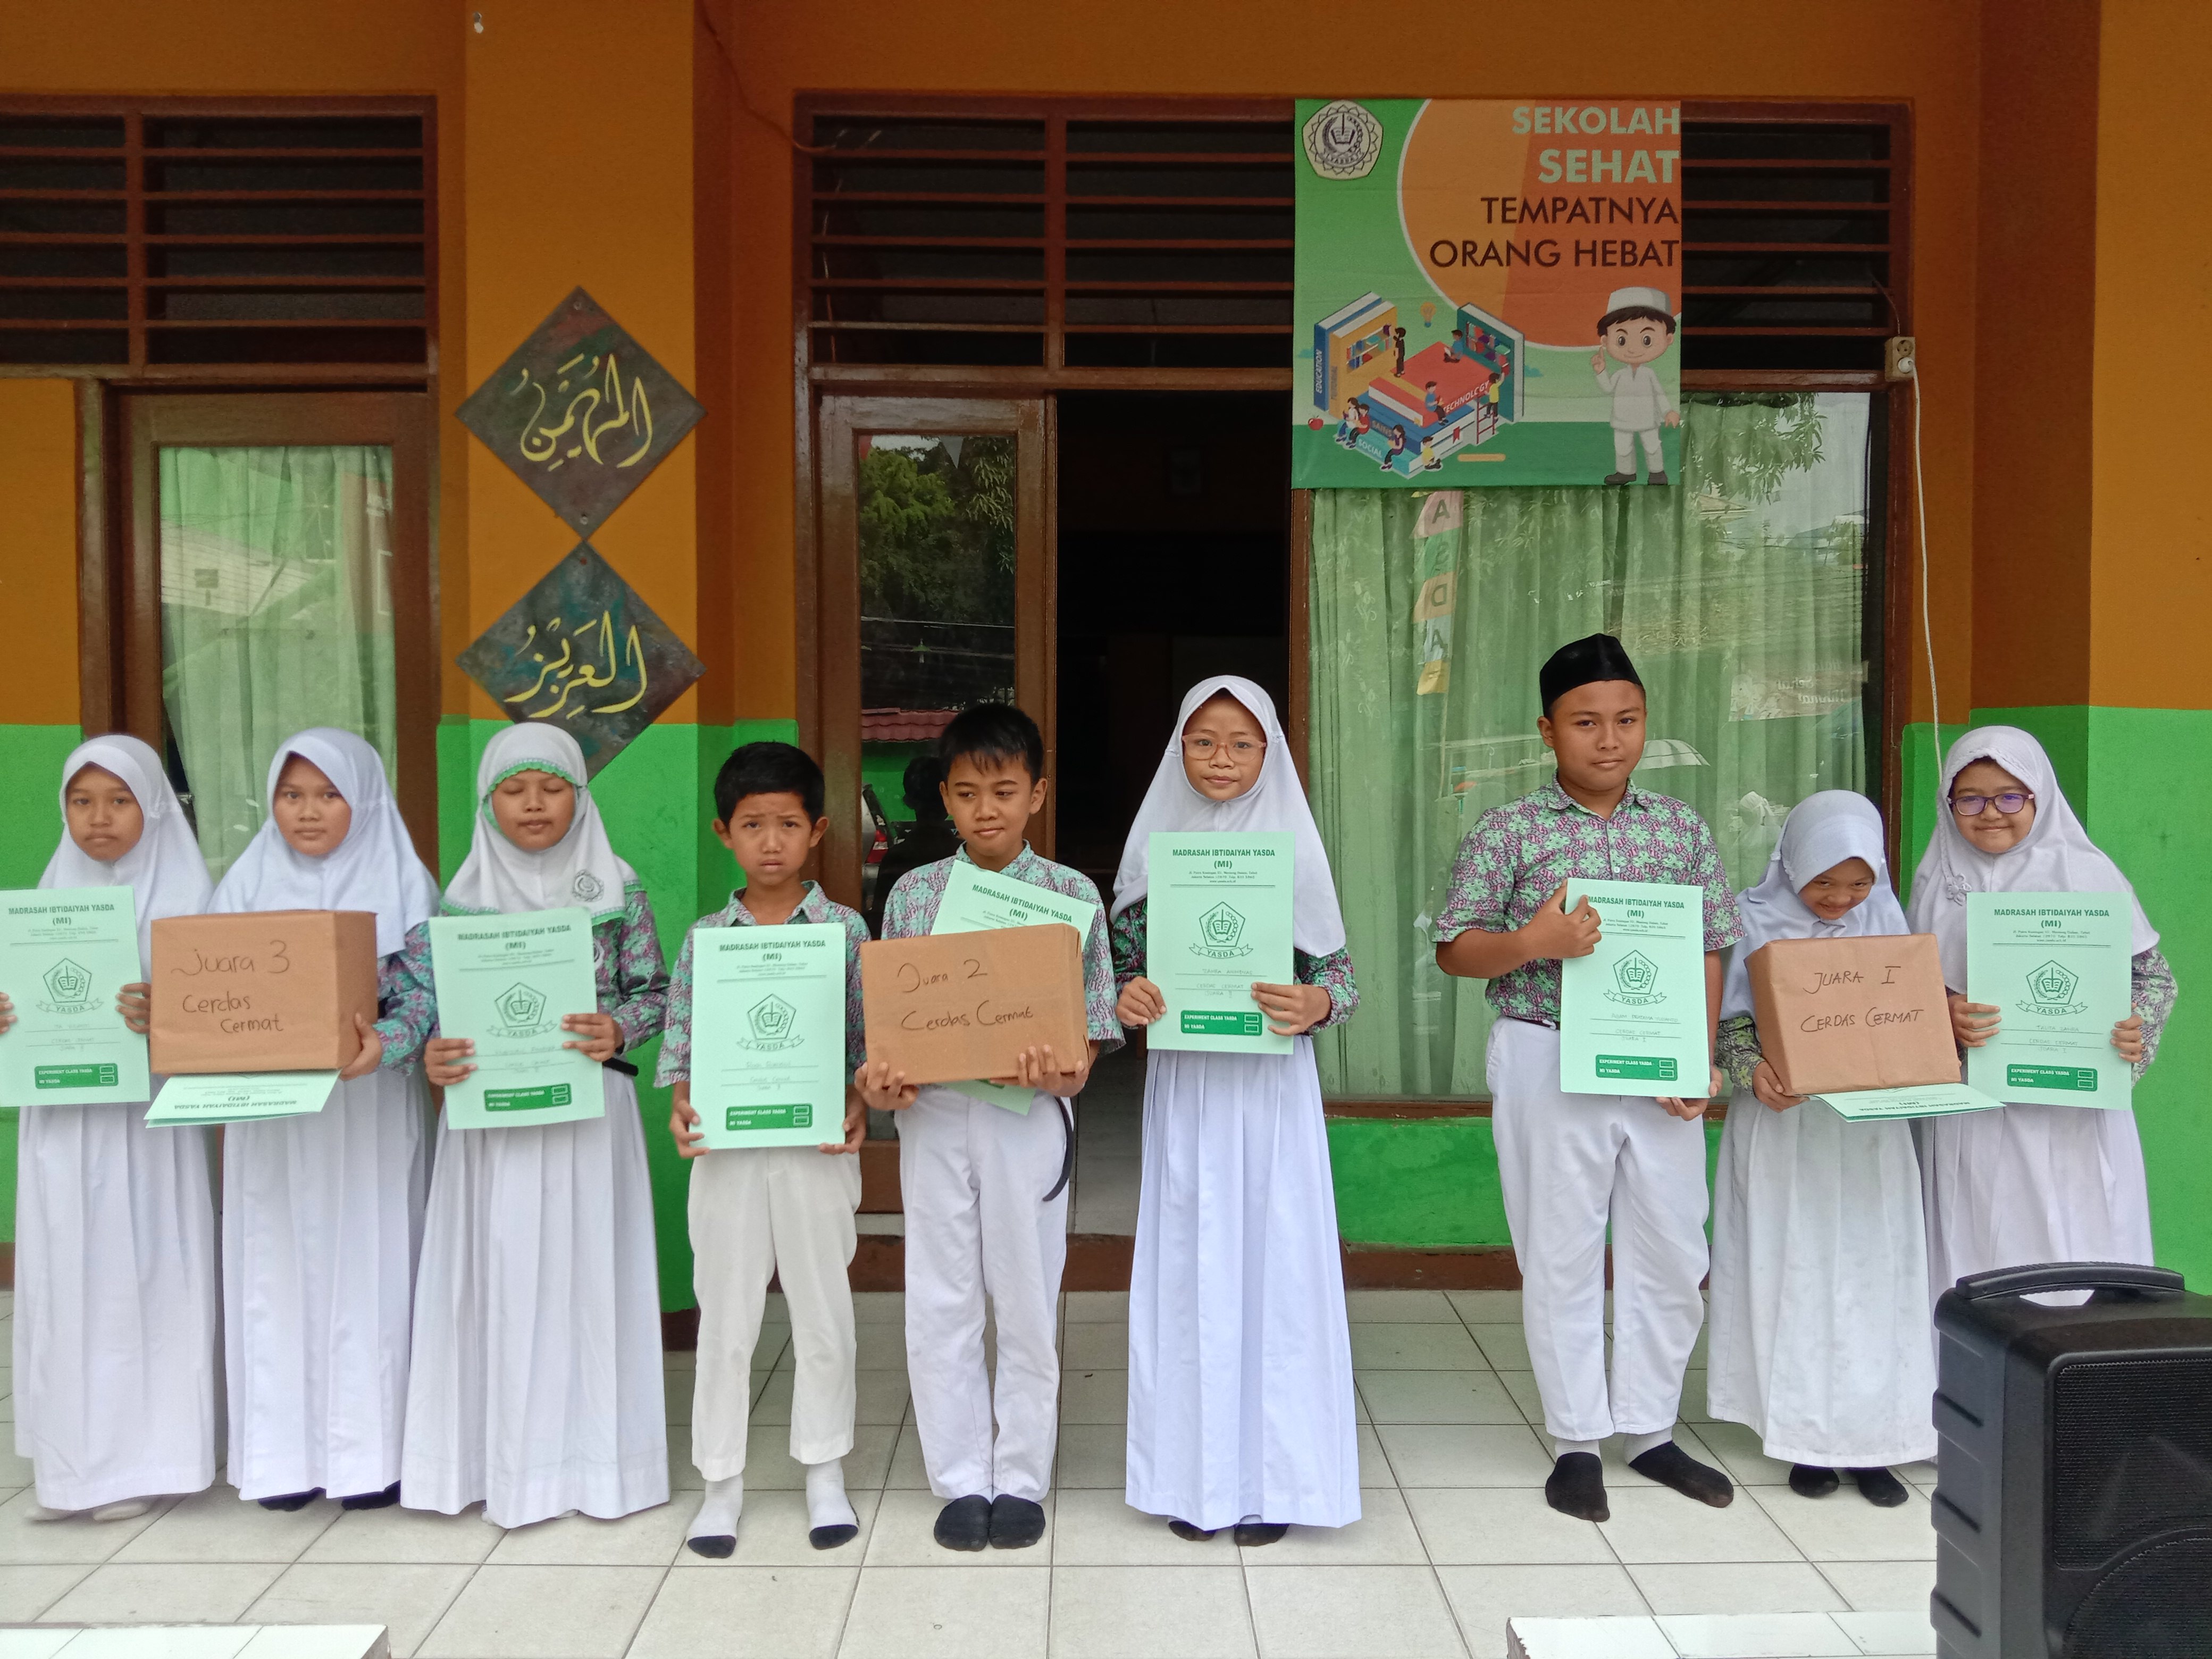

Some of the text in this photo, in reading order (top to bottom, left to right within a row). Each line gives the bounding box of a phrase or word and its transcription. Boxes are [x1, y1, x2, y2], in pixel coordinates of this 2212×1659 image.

[1512, 107, 1679, 134] SEKOLAH
[1539, 149, 1679, 183] SEHAT
[1481, 197, 1679, 224] TEMPATNYA
[1430, 239, 1679, 267] ORANG HEBAT
[1358, 439, 1382, 457] SOCIAL
[972, 884, 1072, 923] MADRASAH IBTIDAIYAH YASDA
[1009, 908, 1028, 921] (MI)
[1626, 899, 1662, 907] IBTIDAIYAH
[1627, 910, 1644, 918] (MI)
[2041, 920, 2062, 928] (MI)
[269, 940, 290, 974] 3
[719, 943, 759, 951] MADRASAH
[763, 953, 782, 961] (MI)
[898, 959, 988, 993] Juara 2
[1803, 970, 1864, 994] JUARA
[182, 991, 250, 1013] Cerdas
[901, 1000, 1034, 1031] Cerdas Cermat
[1800, 1007, 1924, 1032] CERDAS CERMAT
